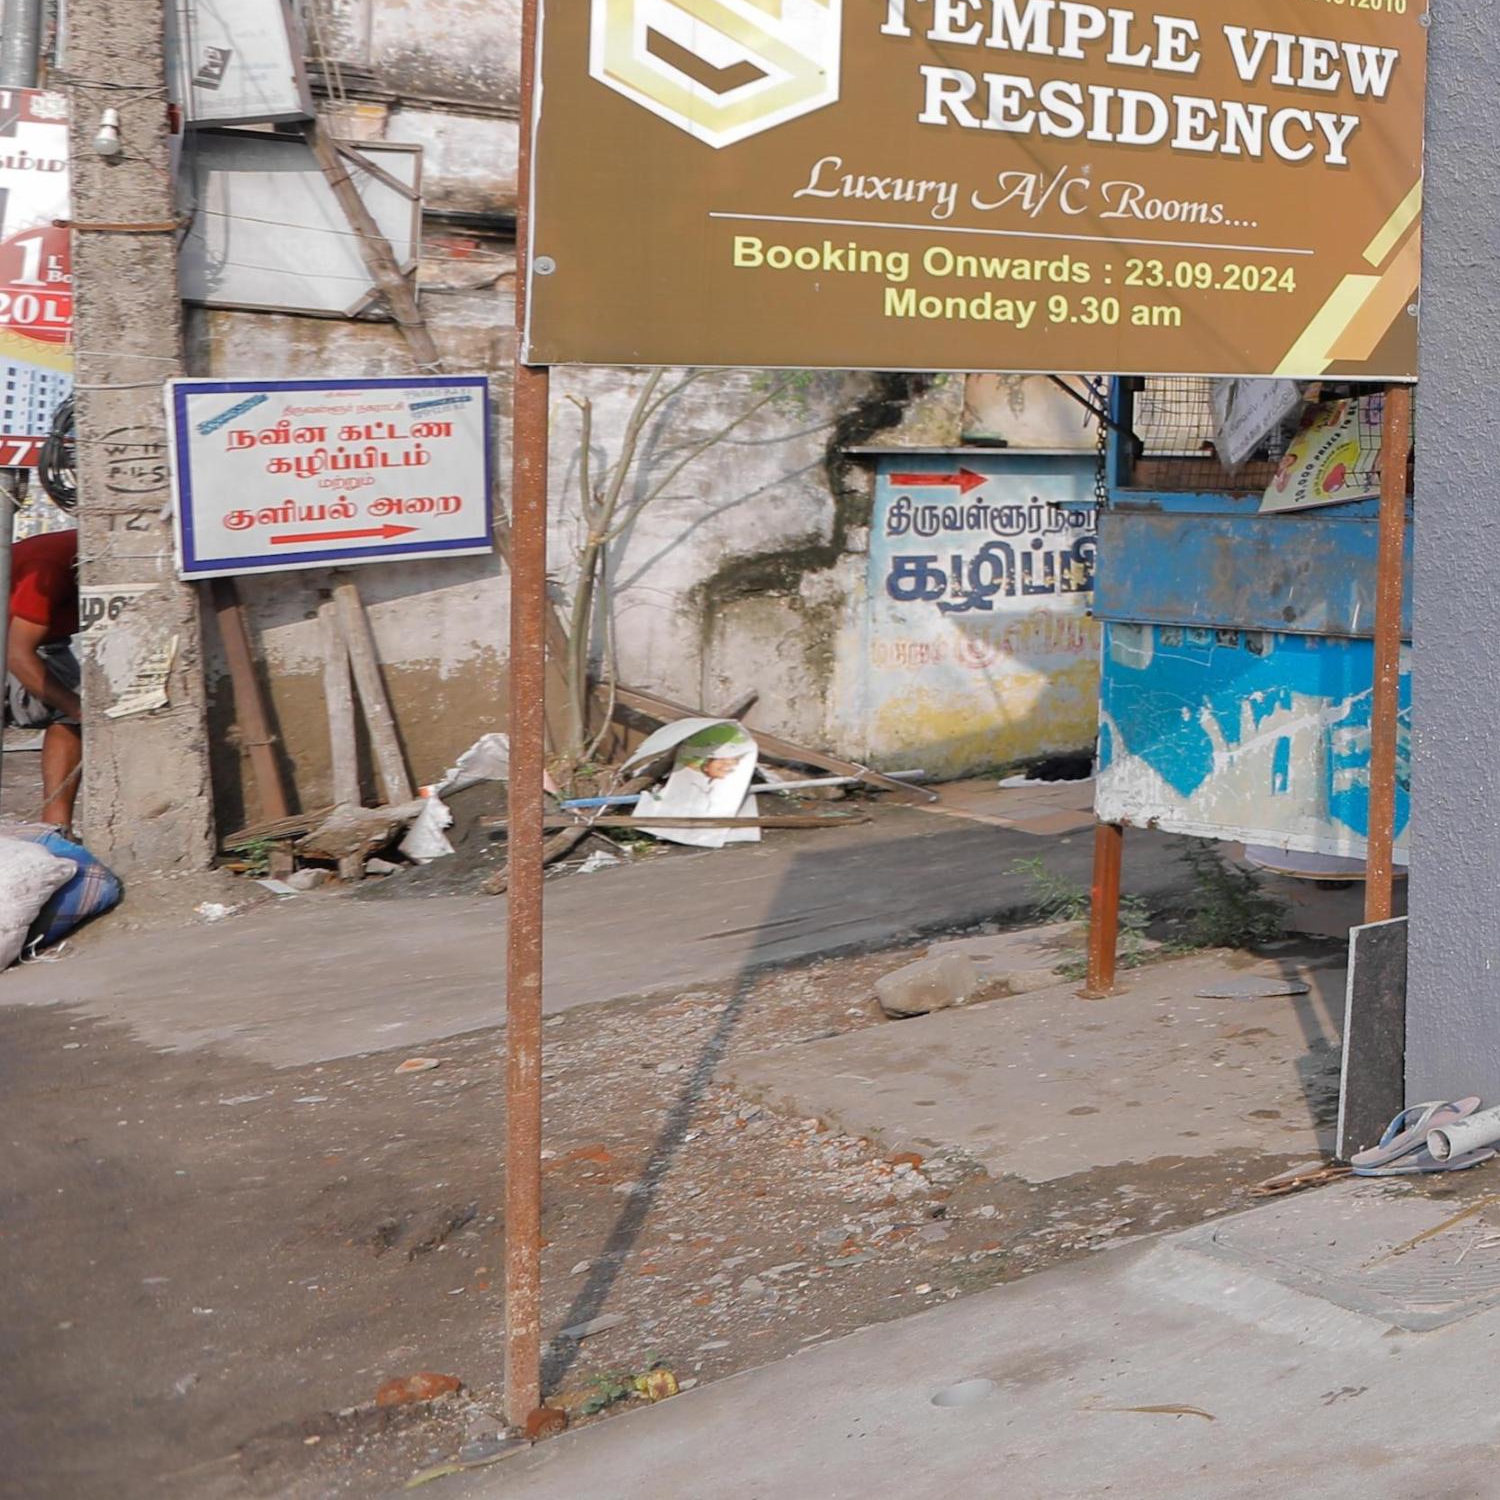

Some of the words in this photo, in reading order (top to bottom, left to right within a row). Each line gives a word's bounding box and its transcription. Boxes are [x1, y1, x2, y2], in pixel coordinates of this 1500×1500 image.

[1222, 25, 1399, 100] VIEW
[917, 65, 1361, 167] RESIDENCY
[793, 155, 957, 218] Luxury
[971, 164, 1091, 217] A/C
[732, 236, 911, 282] Booking
[921, 244, 1093, 286] Onwards
[1124, 258, 1298, 296] 23.09.2024
[883, 286, 1037, 331] Monday
[1047, 293, 1121, 328] 9.30
[1130, 302, 1182, 328] am
[225, 419, 328, 451] நவீன
[338, 420, 454, 441] கட்டண
[266, 443, 431, 478] கழிப்பிடம்
[223, 495, 358, 530] குளியல்
[367, 494, 463, 518] அறை
[886, 496, 1045, 537] திருவள்ளூர்
